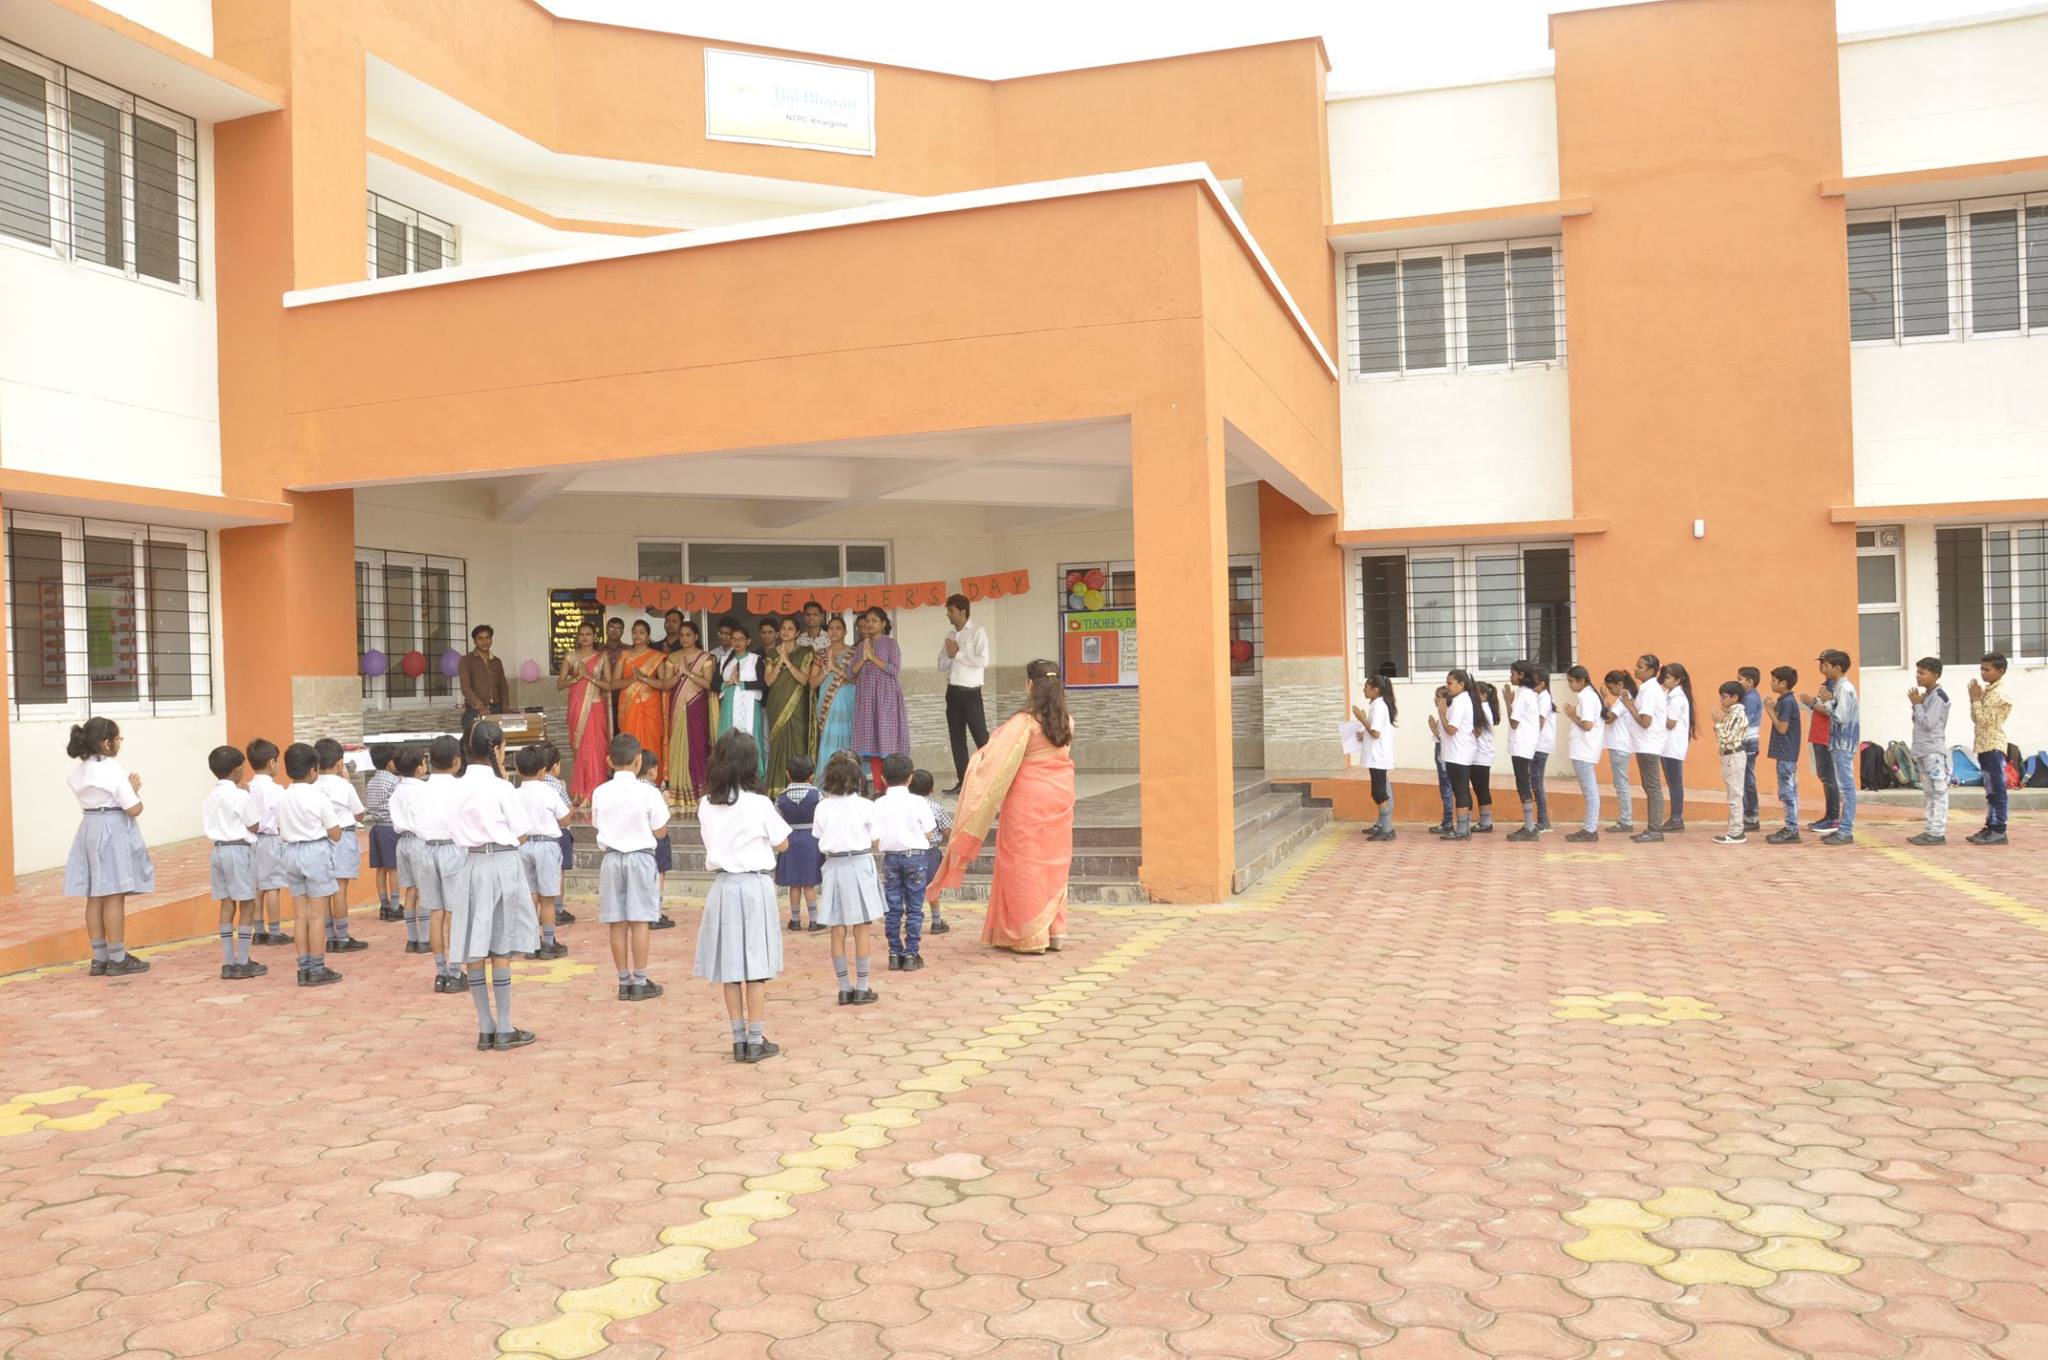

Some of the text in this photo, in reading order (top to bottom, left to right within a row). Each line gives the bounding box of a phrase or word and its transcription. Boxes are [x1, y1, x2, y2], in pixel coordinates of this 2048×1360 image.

[775, 87, 799, 102] Bal
[785, 113, 808, 123] NTPC
[604, 584, 724, 611] HAPPY
[968, 575, 1023, 601] DAY
